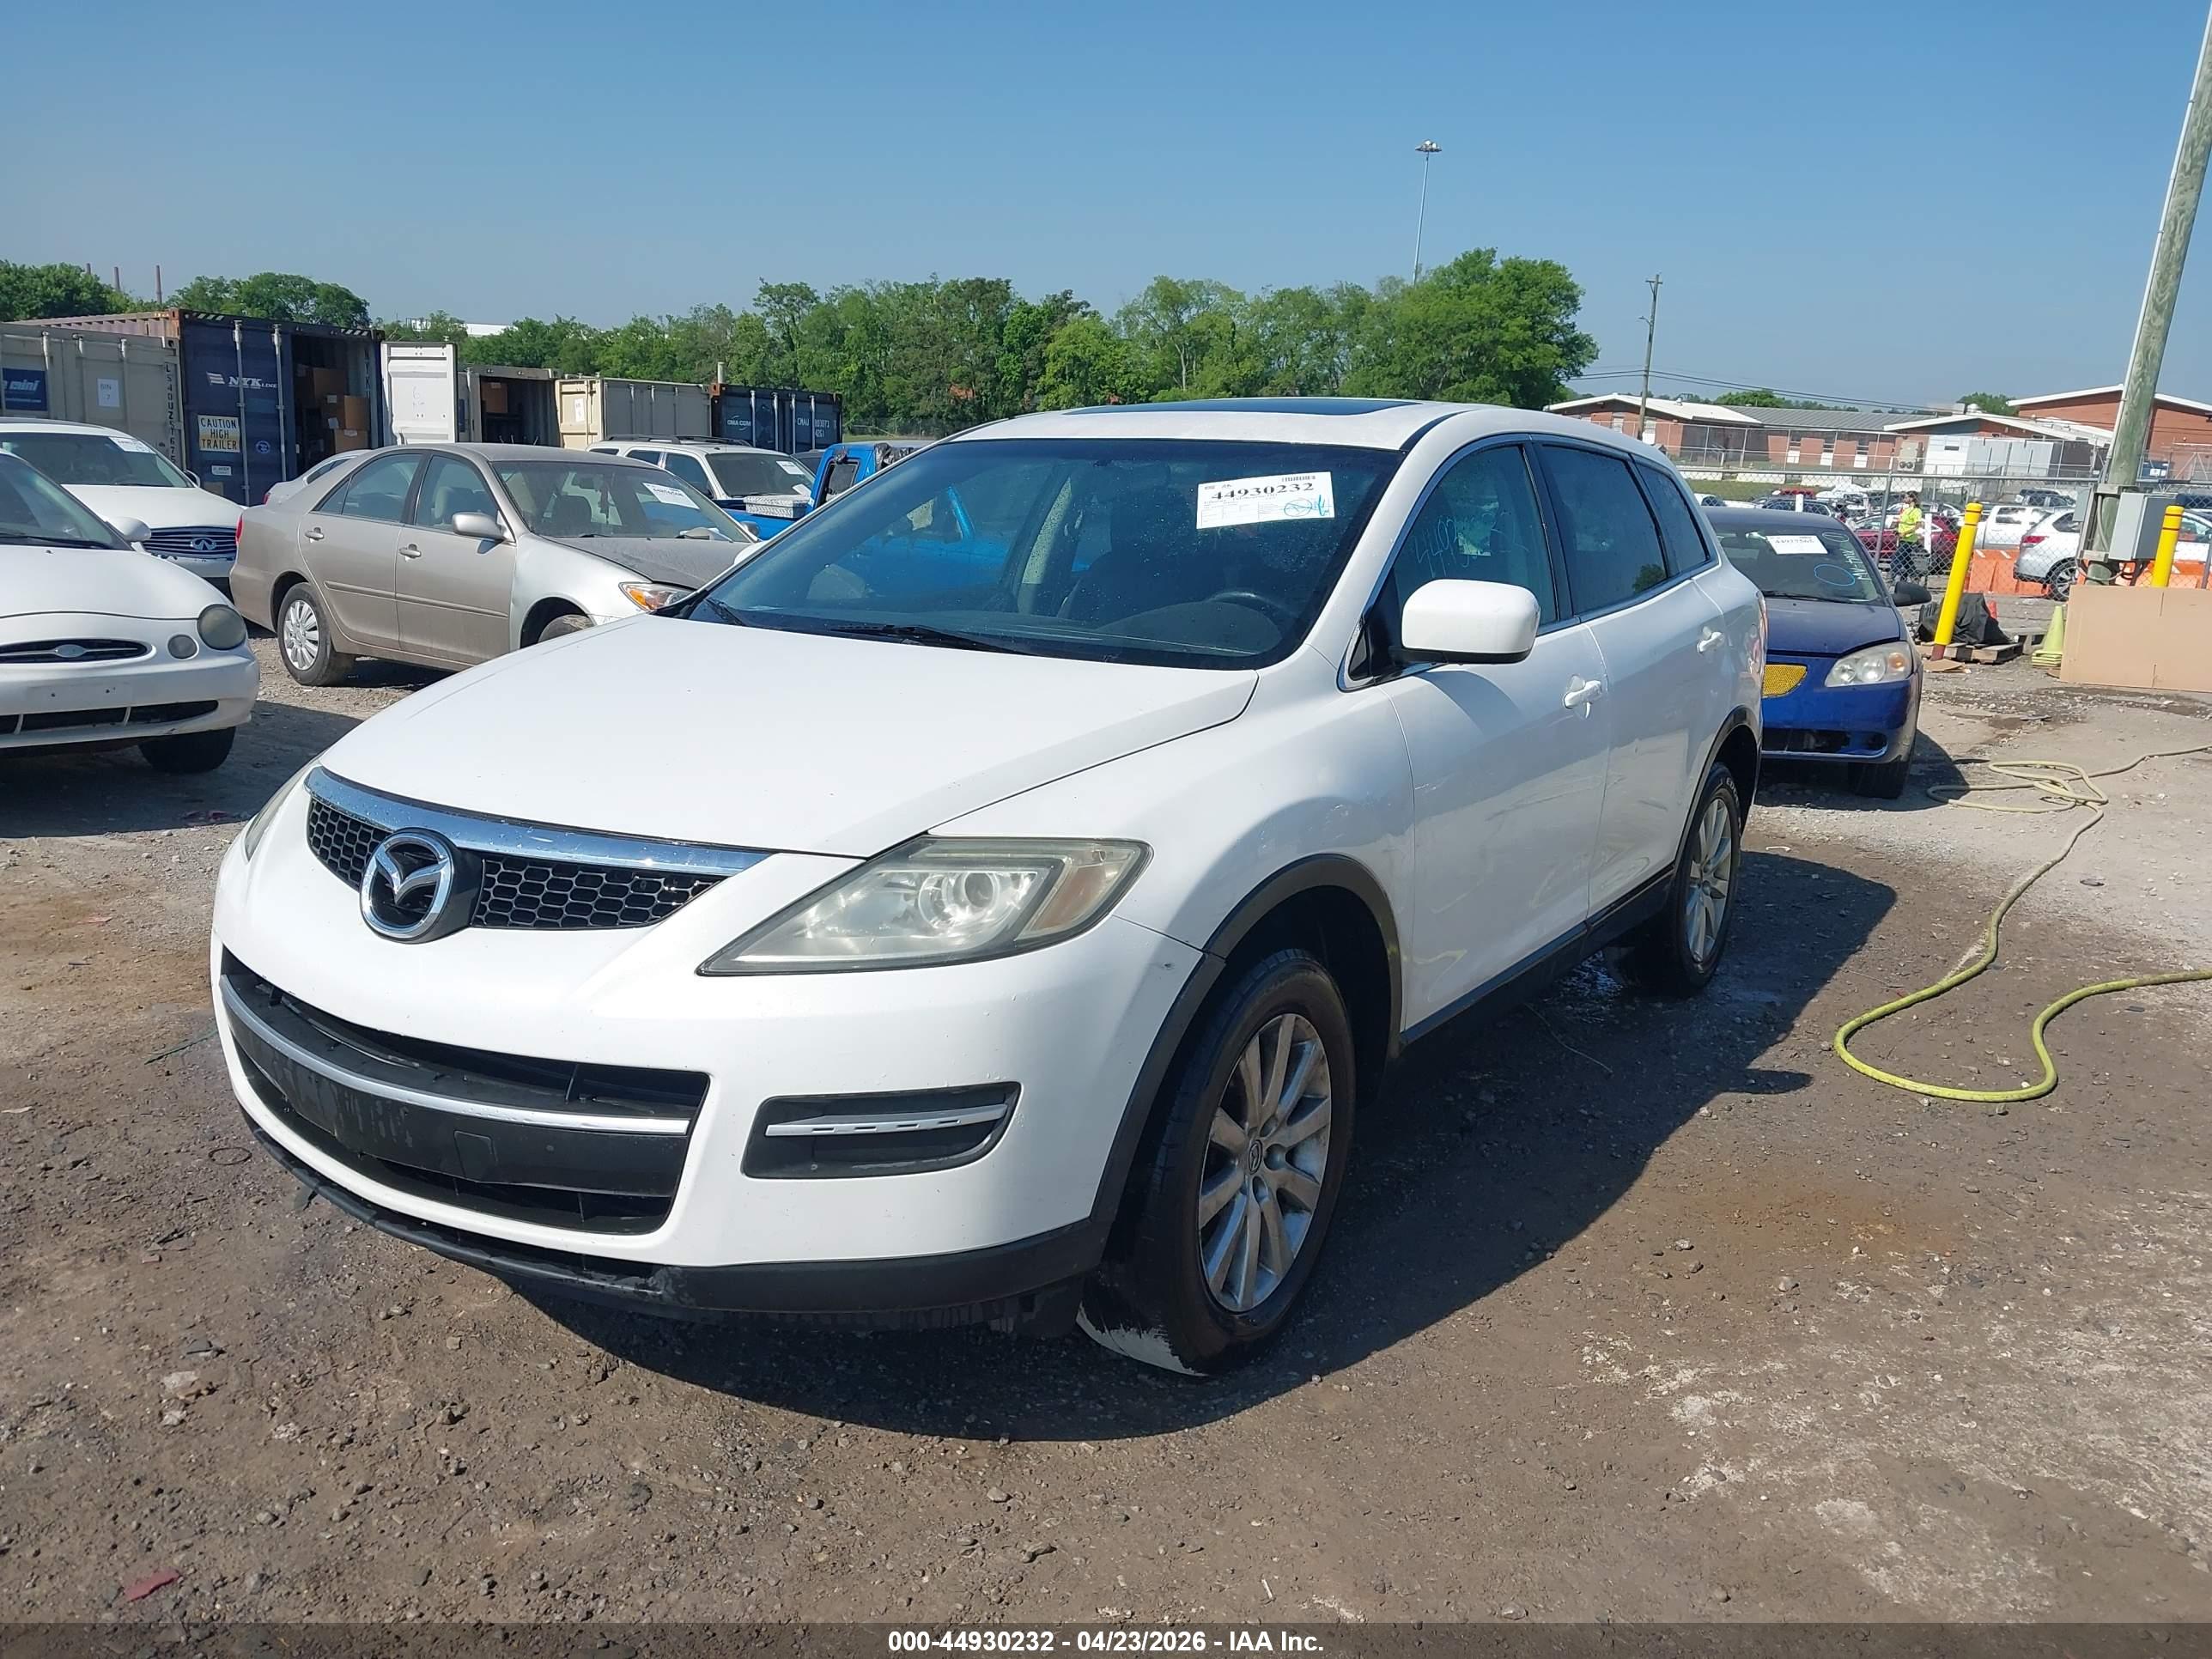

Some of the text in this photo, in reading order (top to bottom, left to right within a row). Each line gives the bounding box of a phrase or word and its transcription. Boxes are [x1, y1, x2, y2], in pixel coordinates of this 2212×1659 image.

[228, 376, 262, 386] NYK
[200, 417, 237, 428] CAUTION
[210, 429, 229, 439] HIGH
[202, 439, 237, 450] TRAILER
[1212, 483, 1314, 500] 44930232
